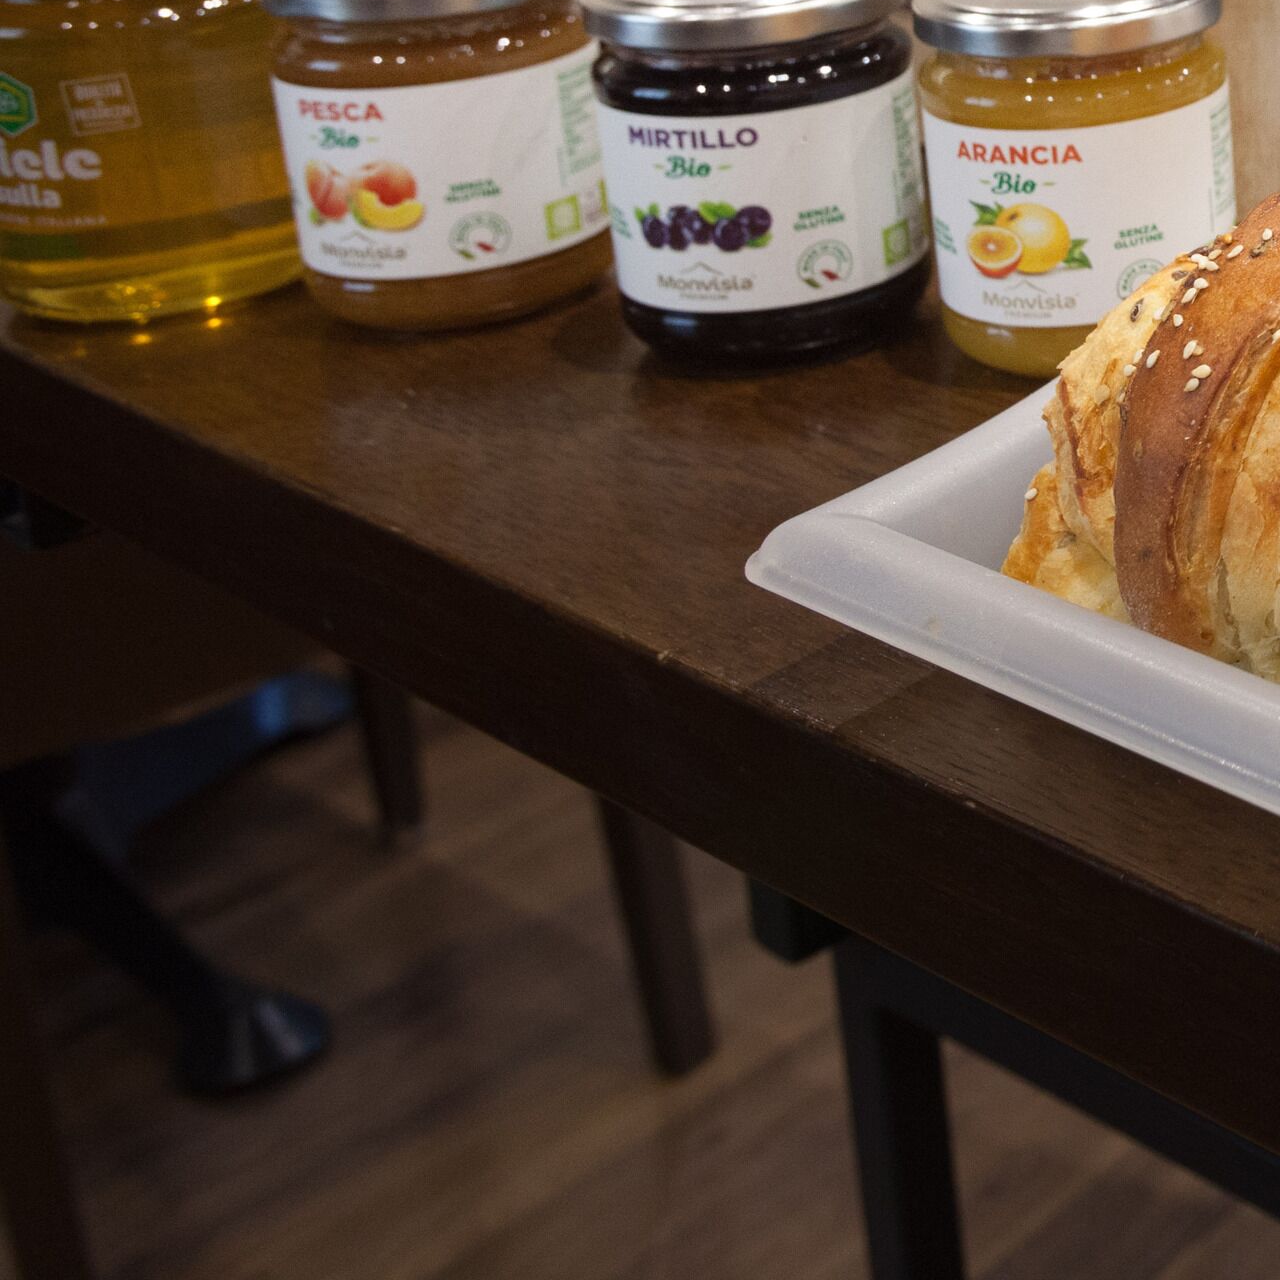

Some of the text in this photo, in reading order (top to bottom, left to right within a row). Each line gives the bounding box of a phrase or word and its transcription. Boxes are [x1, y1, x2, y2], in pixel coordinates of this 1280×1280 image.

[297, 99, 384, 122] PESCA
[318, 126, 361, 149] Bio
[628, 126, 758, 149] MIRTILLO
[957, 141, 1083, 165] ARANCIA
[665, 156, 712, 178] Bio
[991, 172, 1037, 194] Bio
[1114, 231, 1164, 251] GLUTINE
[1119, 223, 1159, 239] SENZA
[982, 291, 1077, 309] Monvisia
